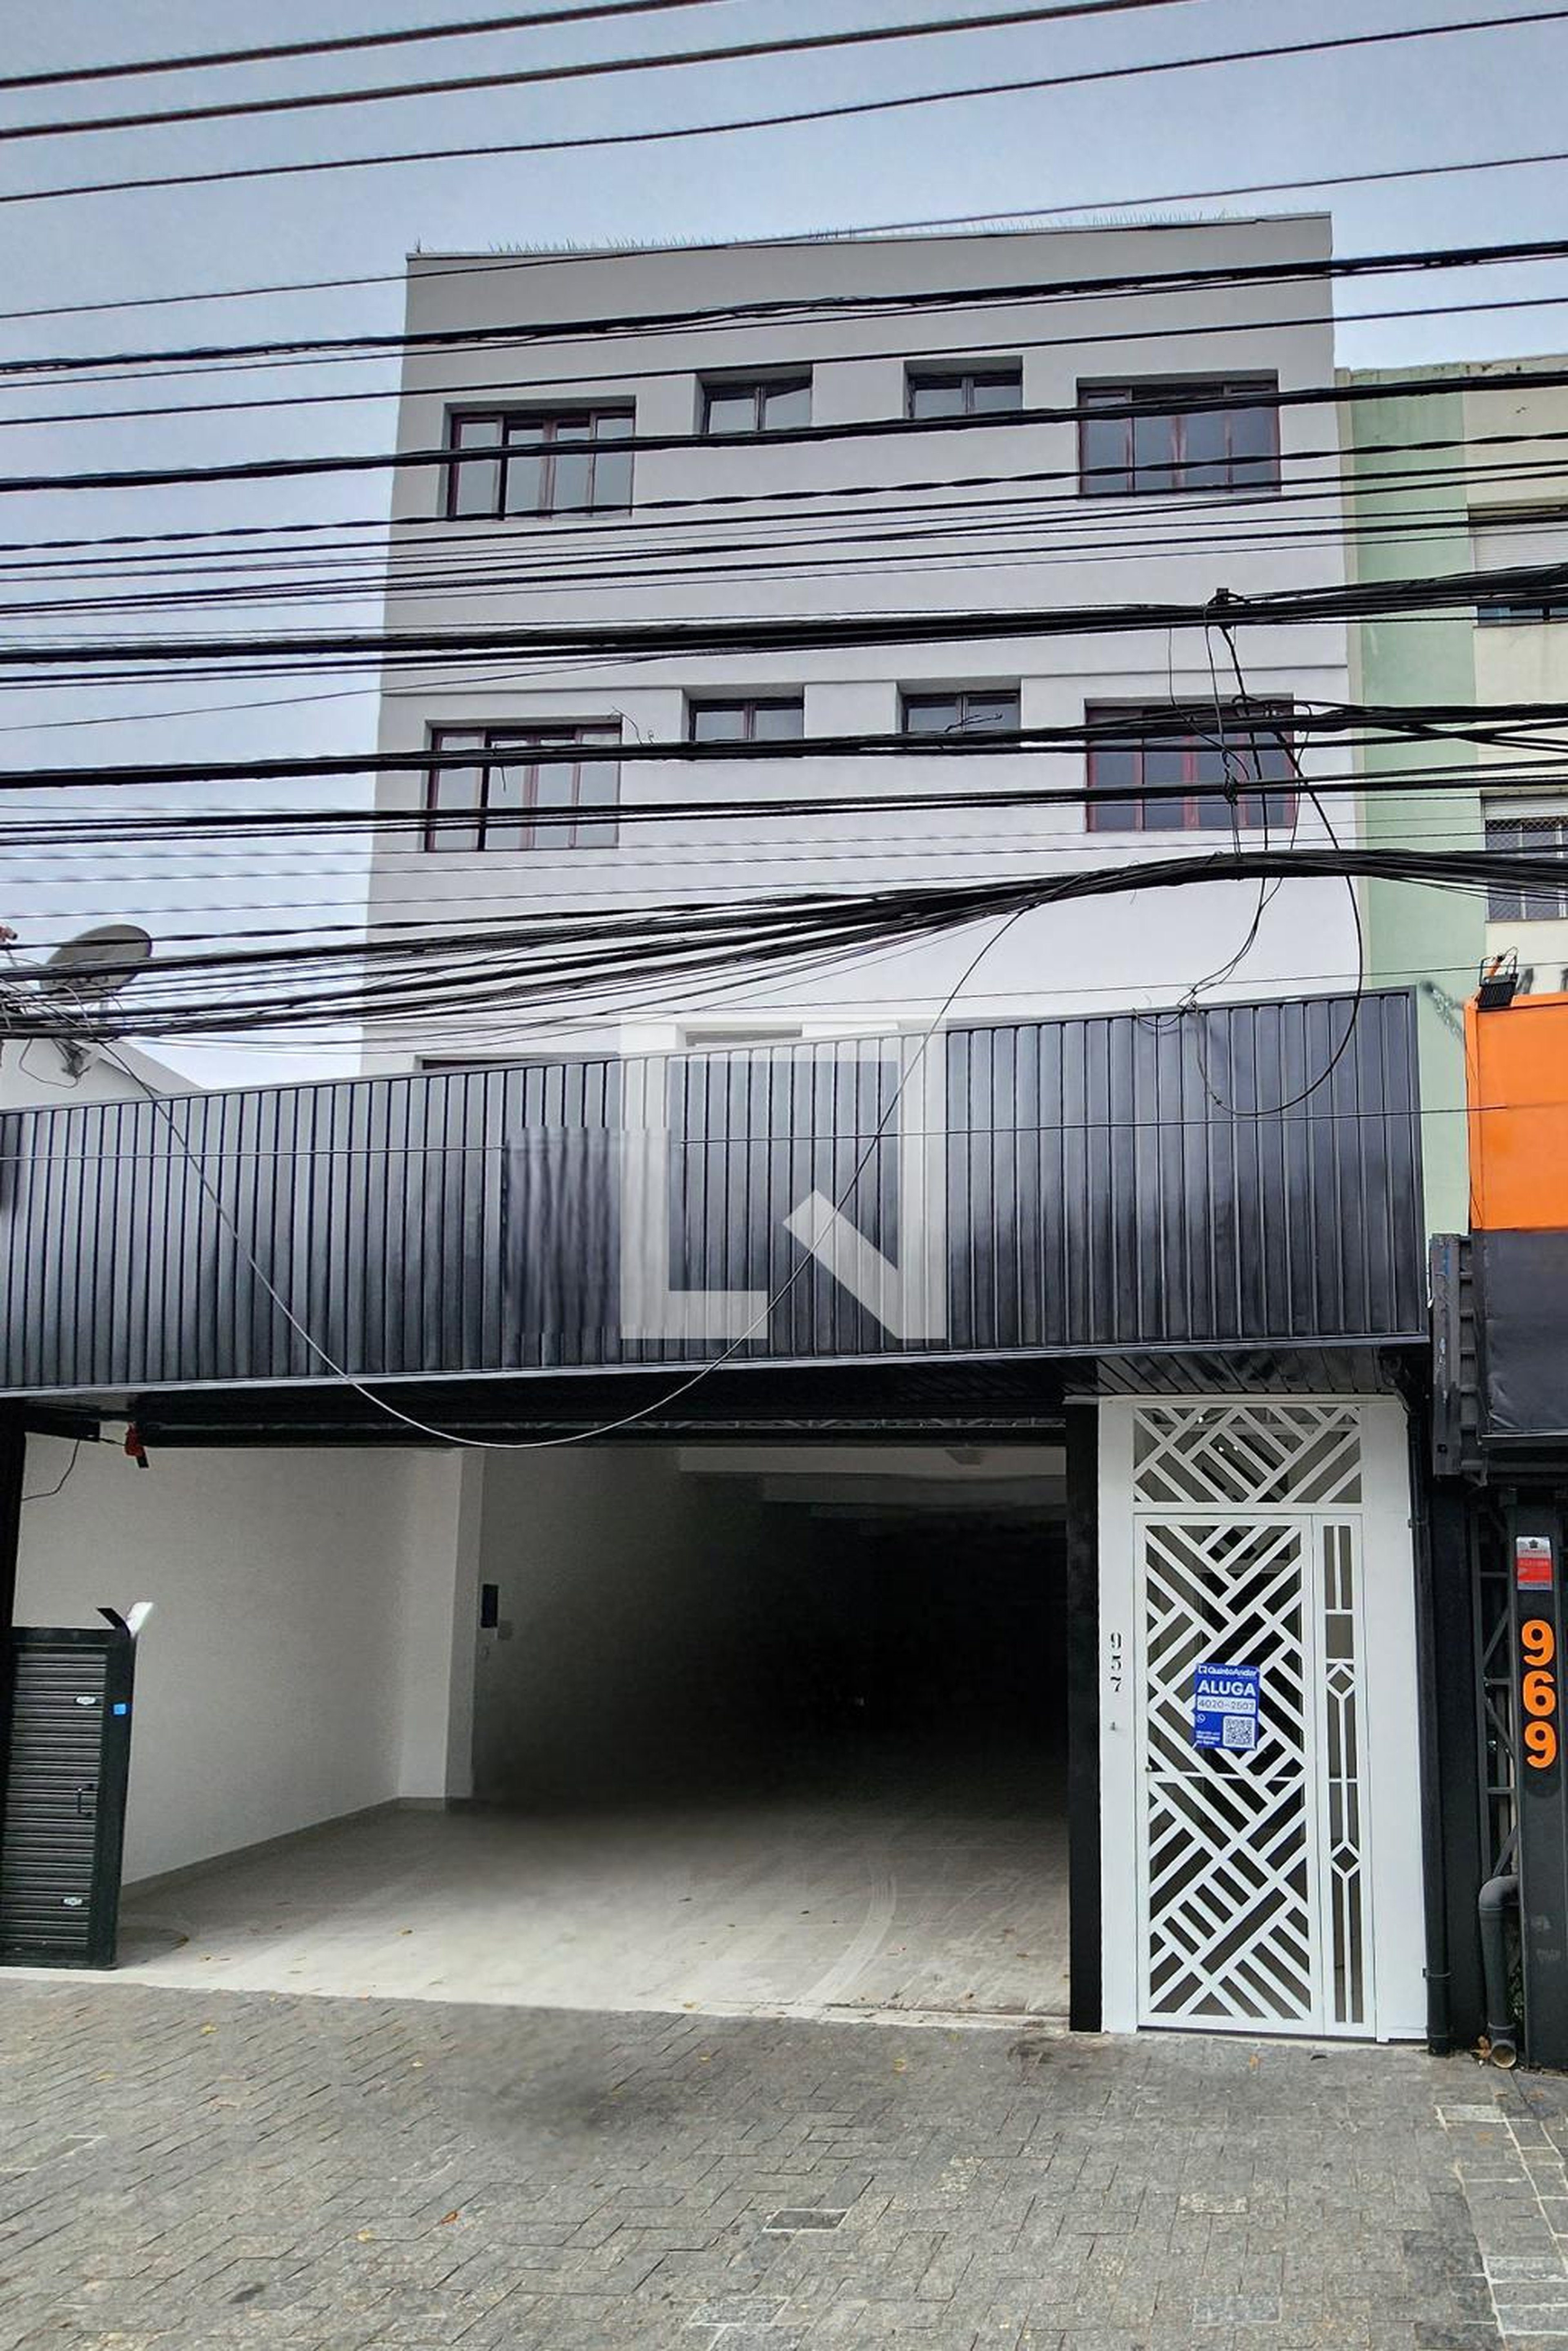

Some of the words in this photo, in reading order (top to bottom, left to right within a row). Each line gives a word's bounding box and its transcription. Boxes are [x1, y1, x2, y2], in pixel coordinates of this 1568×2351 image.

[1110, 1633, 1121, 1692] 957
[1197, 1680, 1256, 1697] ALUGA
[1521, 1619, 1557, 1769] 969
